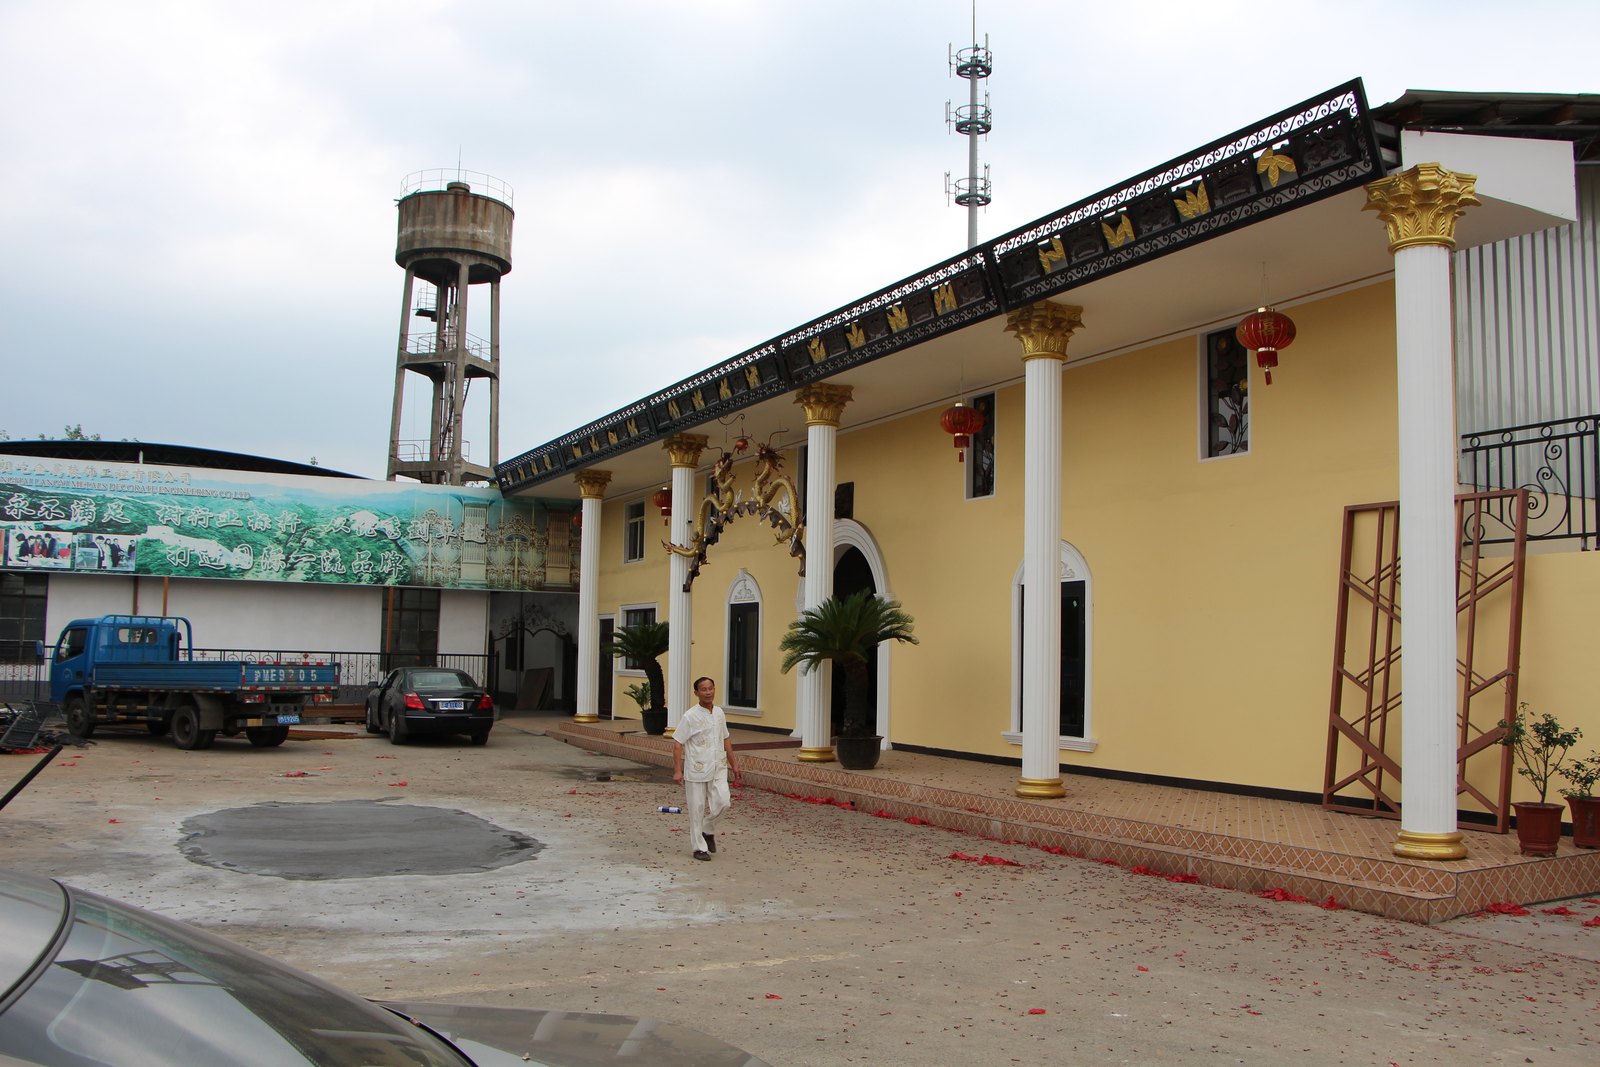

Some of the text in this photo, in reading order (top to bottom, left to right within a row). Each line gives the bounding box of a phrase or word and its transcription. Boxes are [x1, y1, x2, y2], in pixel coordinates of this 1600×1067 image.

[158, 486, 218, 498] ENGINEERING
[4, 493, 131, 524] 永不满足
[155, 505, 301, 535] 树行业标杆
[166, 543, 405, 578] 打造国际一流品牌
